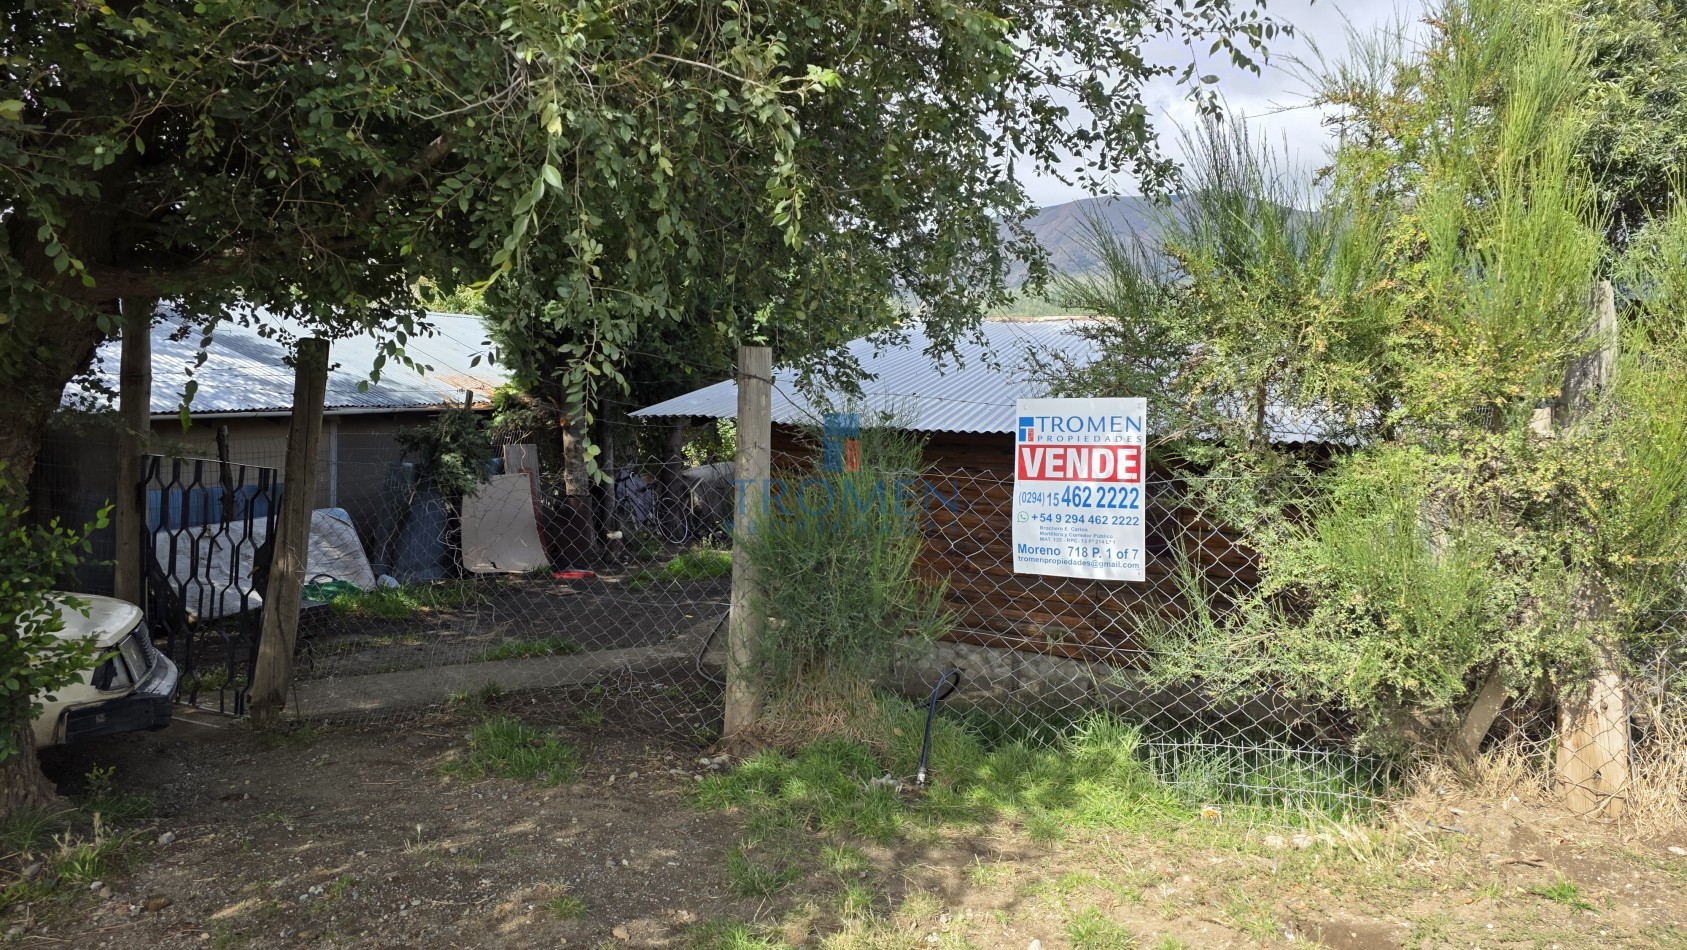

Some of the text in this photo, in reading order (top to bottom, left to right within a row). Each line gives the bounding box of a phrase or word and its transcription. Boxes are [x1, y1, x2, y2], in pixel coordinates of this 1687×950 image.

[1036, 416, 1142, 432] TROMEN
[1022, 448, 1138, 480] VENDE
[1018, 486, 1140, 509] (0294) 15 462 2222
[1056, 514, 1062, 522] 9
[1065, 514, 1085, 524] 294
[1088, 516, 1108, 524] 462
[1112, 516, 1140, 526] 2222
[1018, 544, 1138, 560] Moreno 718 P. 1 of 7
[1018, 556, 1140, 568] tromenpropiedades@gmail.com
